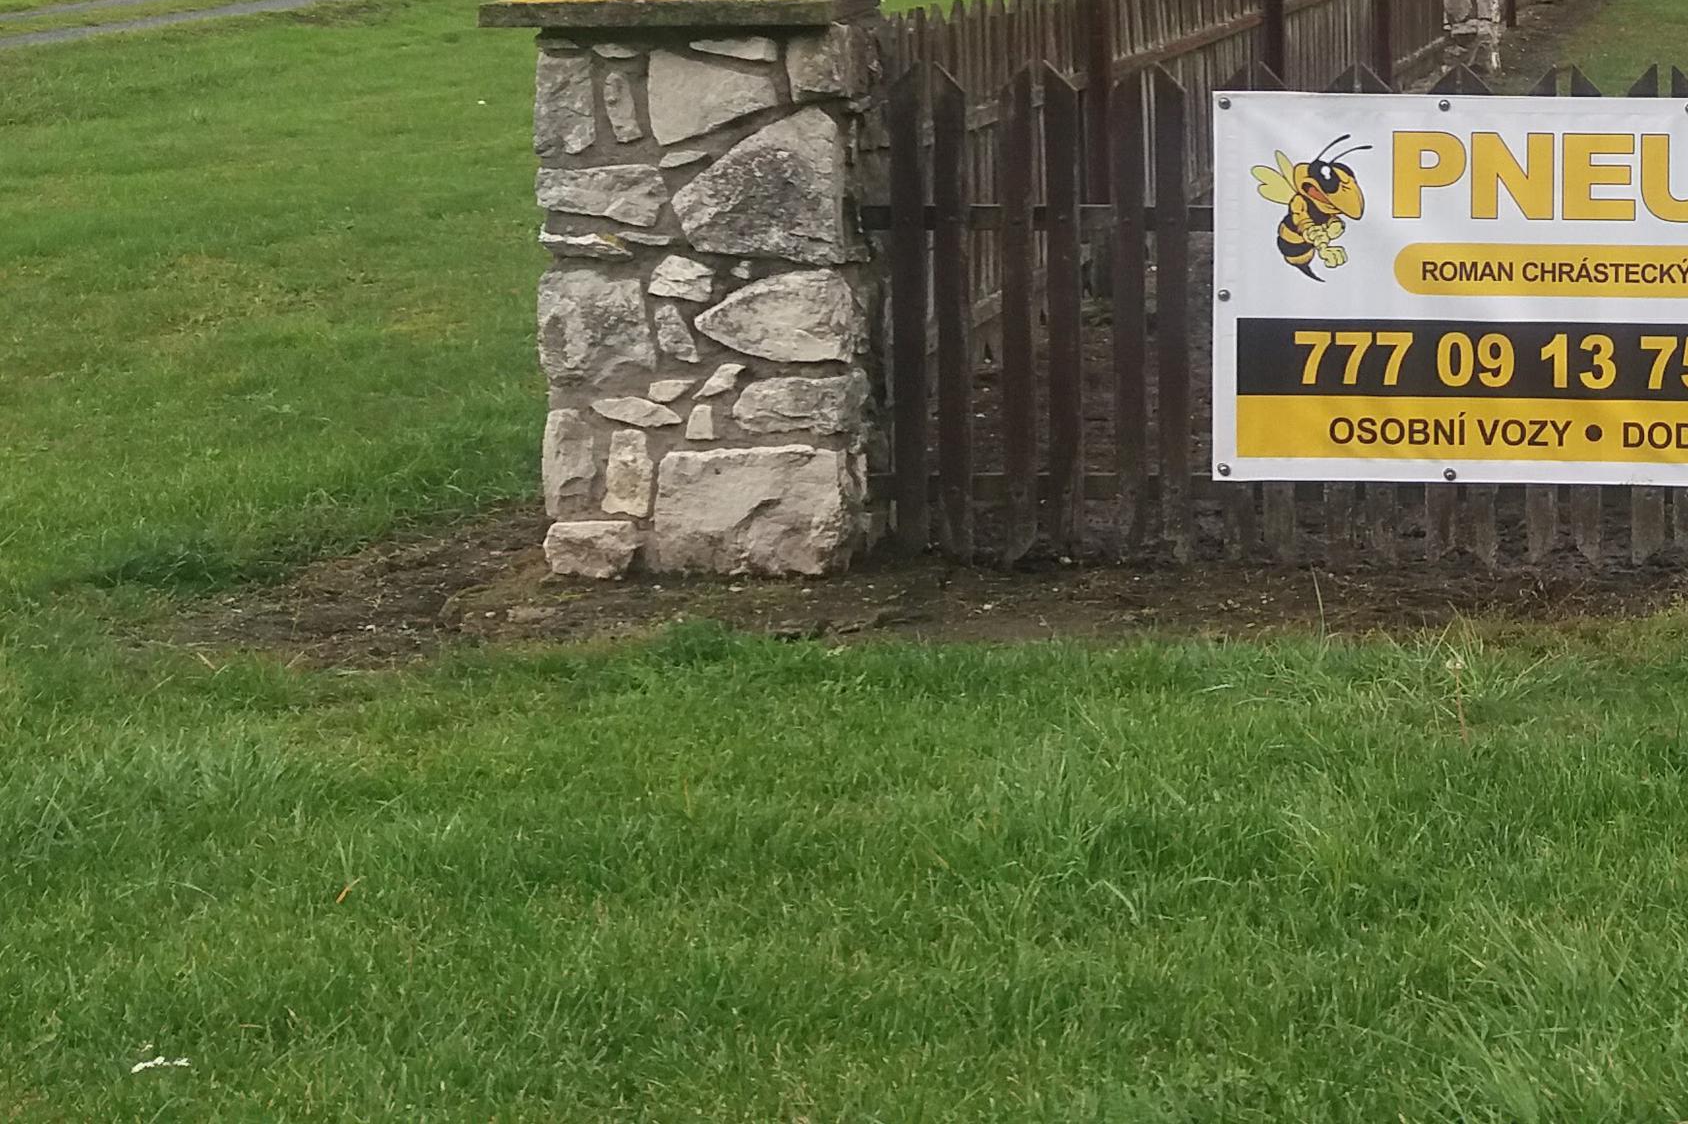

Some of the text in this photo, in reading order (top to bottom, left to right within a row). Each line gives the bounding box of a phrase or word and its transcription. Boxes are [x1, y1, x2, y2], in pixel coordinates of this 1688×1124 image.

[1421, 260, 1514, 282] ROMAN
[1293, 331, 1414, 385] 777
[1436, 332, 1514, 388] 09
[1540, 333, 1617, 389] 13
[1329, 411, 1466, 446] OSOBNÍ
[1477, 419, 1572, 447] VOZY
